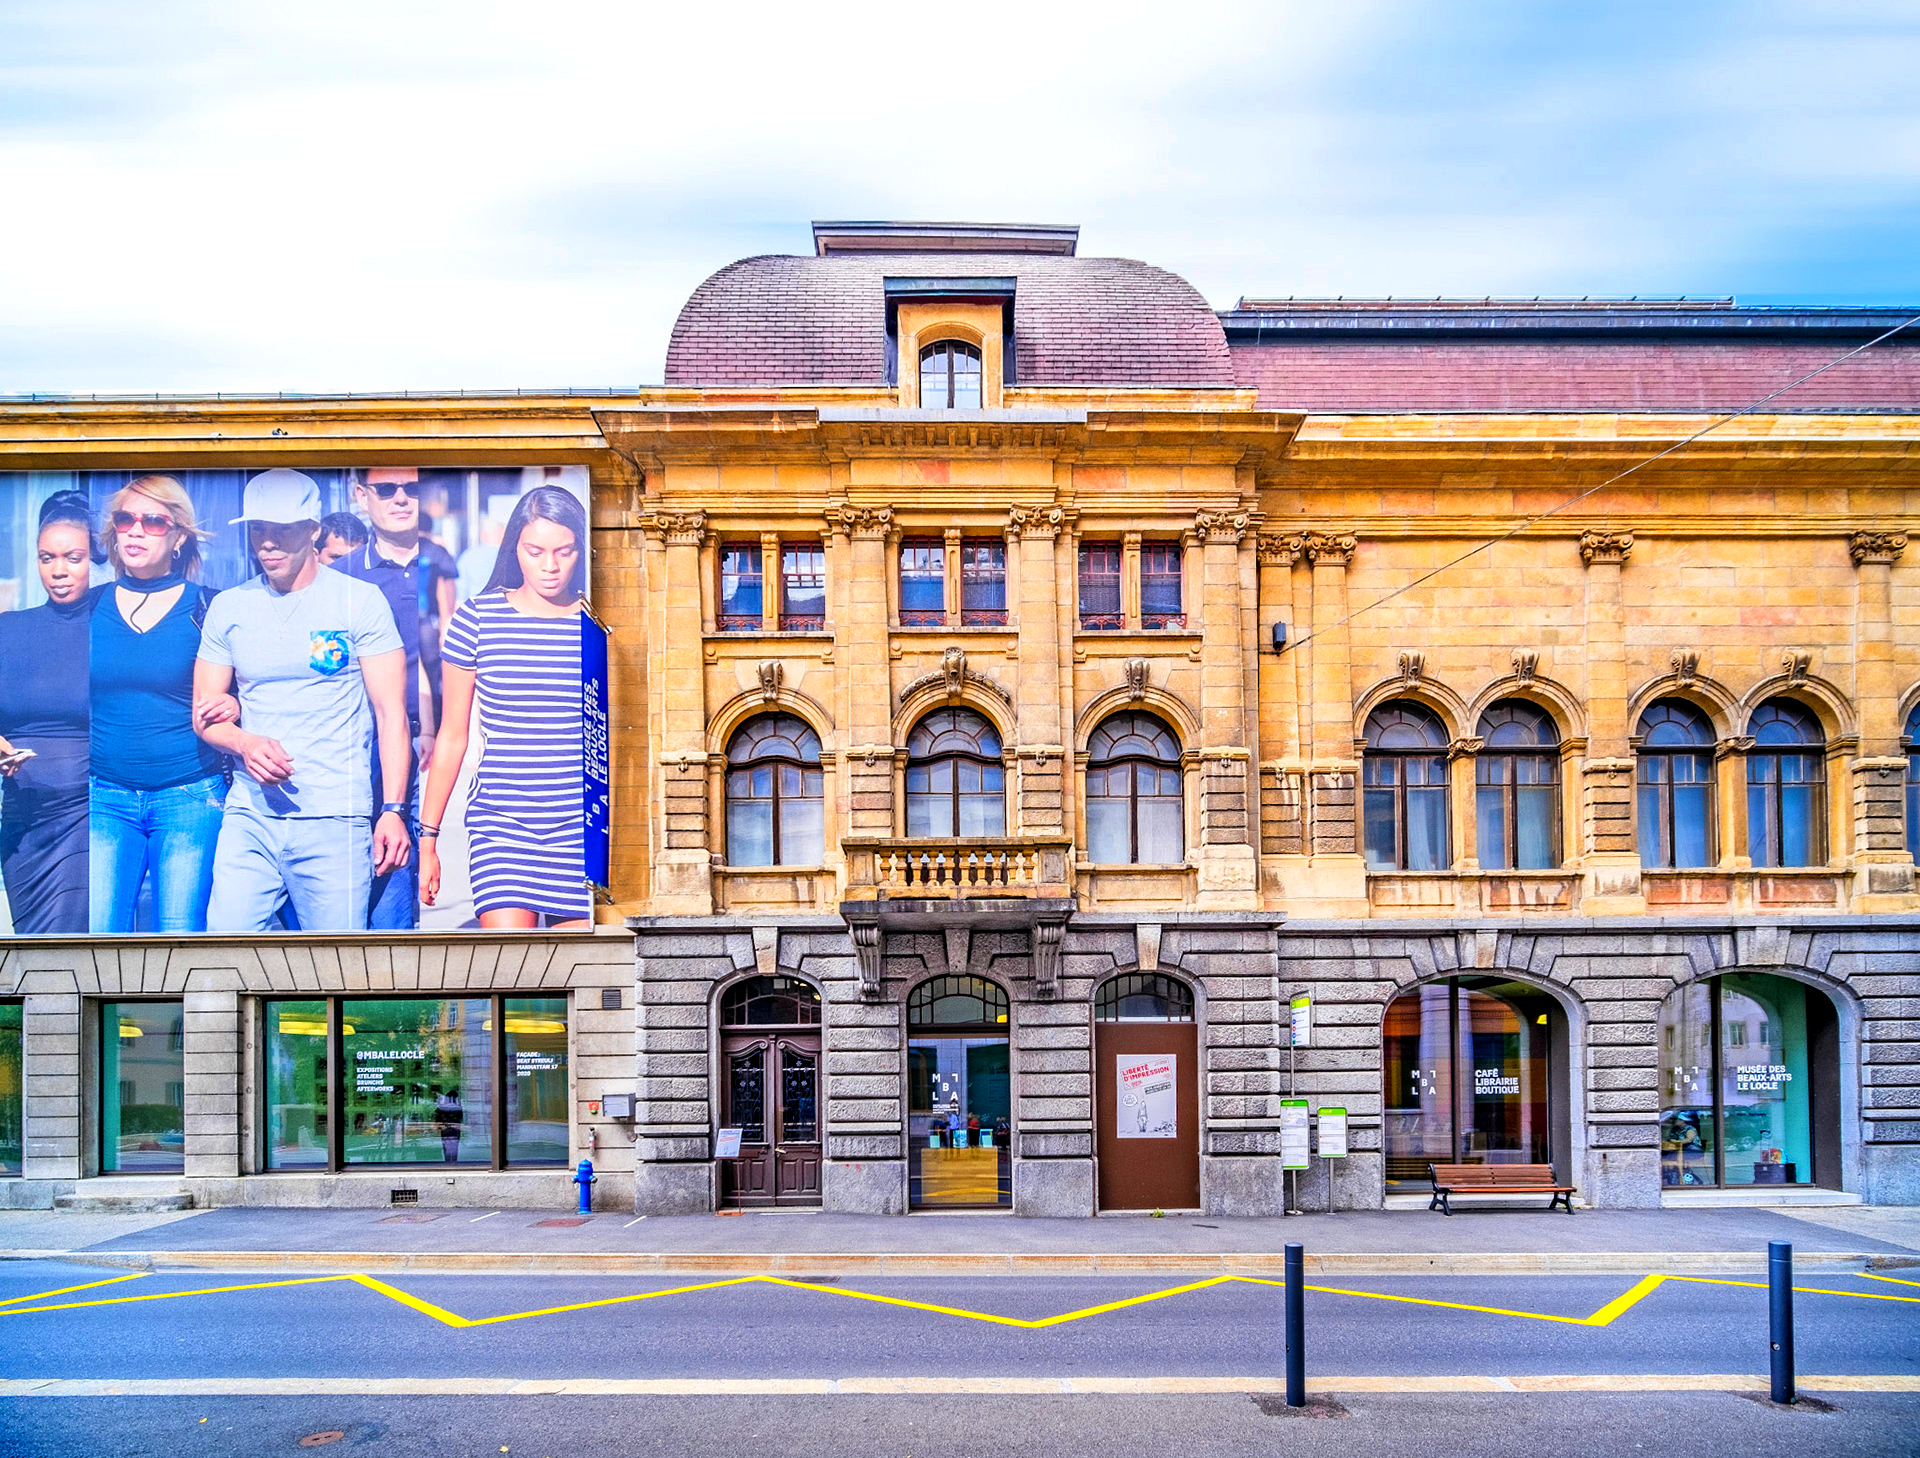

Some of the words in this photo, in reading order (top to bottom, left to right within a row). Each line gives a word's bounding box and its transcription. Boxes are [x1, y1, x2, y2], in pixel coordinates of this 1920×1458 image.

[584, 682, 592, 717] DES
[591, 678, 599, 780] BEAUX-ARTS
[598, 711, 607, 762] LOCLE
[599, 763, 608, 784] LE
[356, 1051, 425, 1059] @MBALELOCLE
[1122, 1064, 1148, 1076] LIBERTÉ
[1475, 1068, 1498, 1077] CAFÉ
[1674, 1066, 1682, 1074] M
[1737, 1064, 1767, 1074] MUSÉE
[932, 1074, 940, 1082] M
[1124, 1066, 1169, 1082] D'IMPRESSION
[1411, 1070, 1420, 1078] M
[1684, 1074, 1690, 1083] B
[1737, 1074, 1792, 1082] BEAUX-ARTS
[942, 1082, 950, 1091] B
[1421, 1078, 1428, 1086] B
[1475, 1078, 1518, 1086] LIBRAIRIE
[1674, 1082, 1682, 1091] L
[1691, 1082, 1698, 1091] A
[1737, 1082, 1749, 1090] LE
[1750, 1082, 1778, 1090] LOCLE
[1412, 1086, 1418, 1095] L
[1428, 1086, 1436, 1095] A
[1475, 1086, 1520, 1094] BOUTIQUE
[932, 1092, 939, 1100] L
[950, 1092, 958, 1100] A
